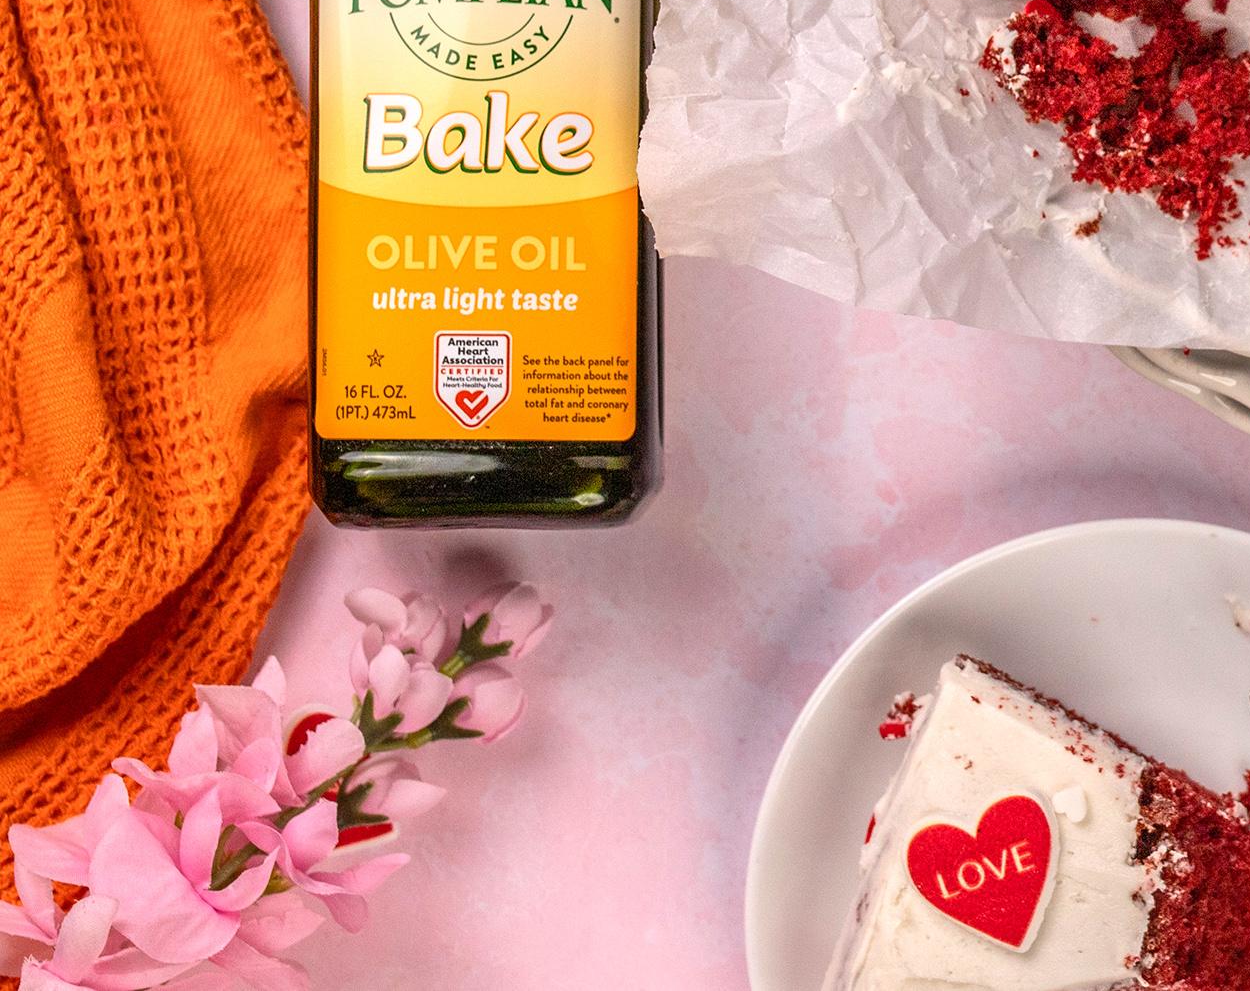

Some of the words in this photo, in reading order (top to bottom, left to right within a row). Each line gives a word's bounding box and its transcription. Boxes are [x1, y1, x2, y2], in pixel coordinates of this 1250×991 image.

[410, 25, 478, 71] MADE
[492, 25, 550, 70] EASY
[363, 90, 595, 176] Bake
[366, 234, 498, 270] OLIVE
[511, 235, 587, 271] OIL
[372, 287, 437, 310] ultra
[443, 287, 505, 316] light
[511, 288, 579, 311] taste
[447, 337, 499, 347] American
[457, 347, 489, 356] Heart
[442, 356, 504, 365] Association
[522, 355, 541, 365] See
[543, 355, 560, 366] the
[562, 355, 586, 366] back
[588, 356, 614, 369] panel
[616, 356, 629, 367] for
[522, 369, 581, 380] information
[583, 370, 611, 380] about
[613, 370, 629, 381] the
[344, 384, 358, 399] 16
[361, 384, 380, 399] FL.
[383, 384, 407, 399] OZ.
[527, 384, 585, 398] relationship
[587, 384, 627, 395] between
[336, 405, 369, 420] (1PT.)
[372, 405, 416, 419] 473mL
[524, 398, 548, 409] total
[550, 398, 564, 409] fat
[567, 398, 585, 409] and
[587, 401, 629, 413] coronary
[543, 412, 569, 423] heart
[935, 840, 1035, 900] LOVE
